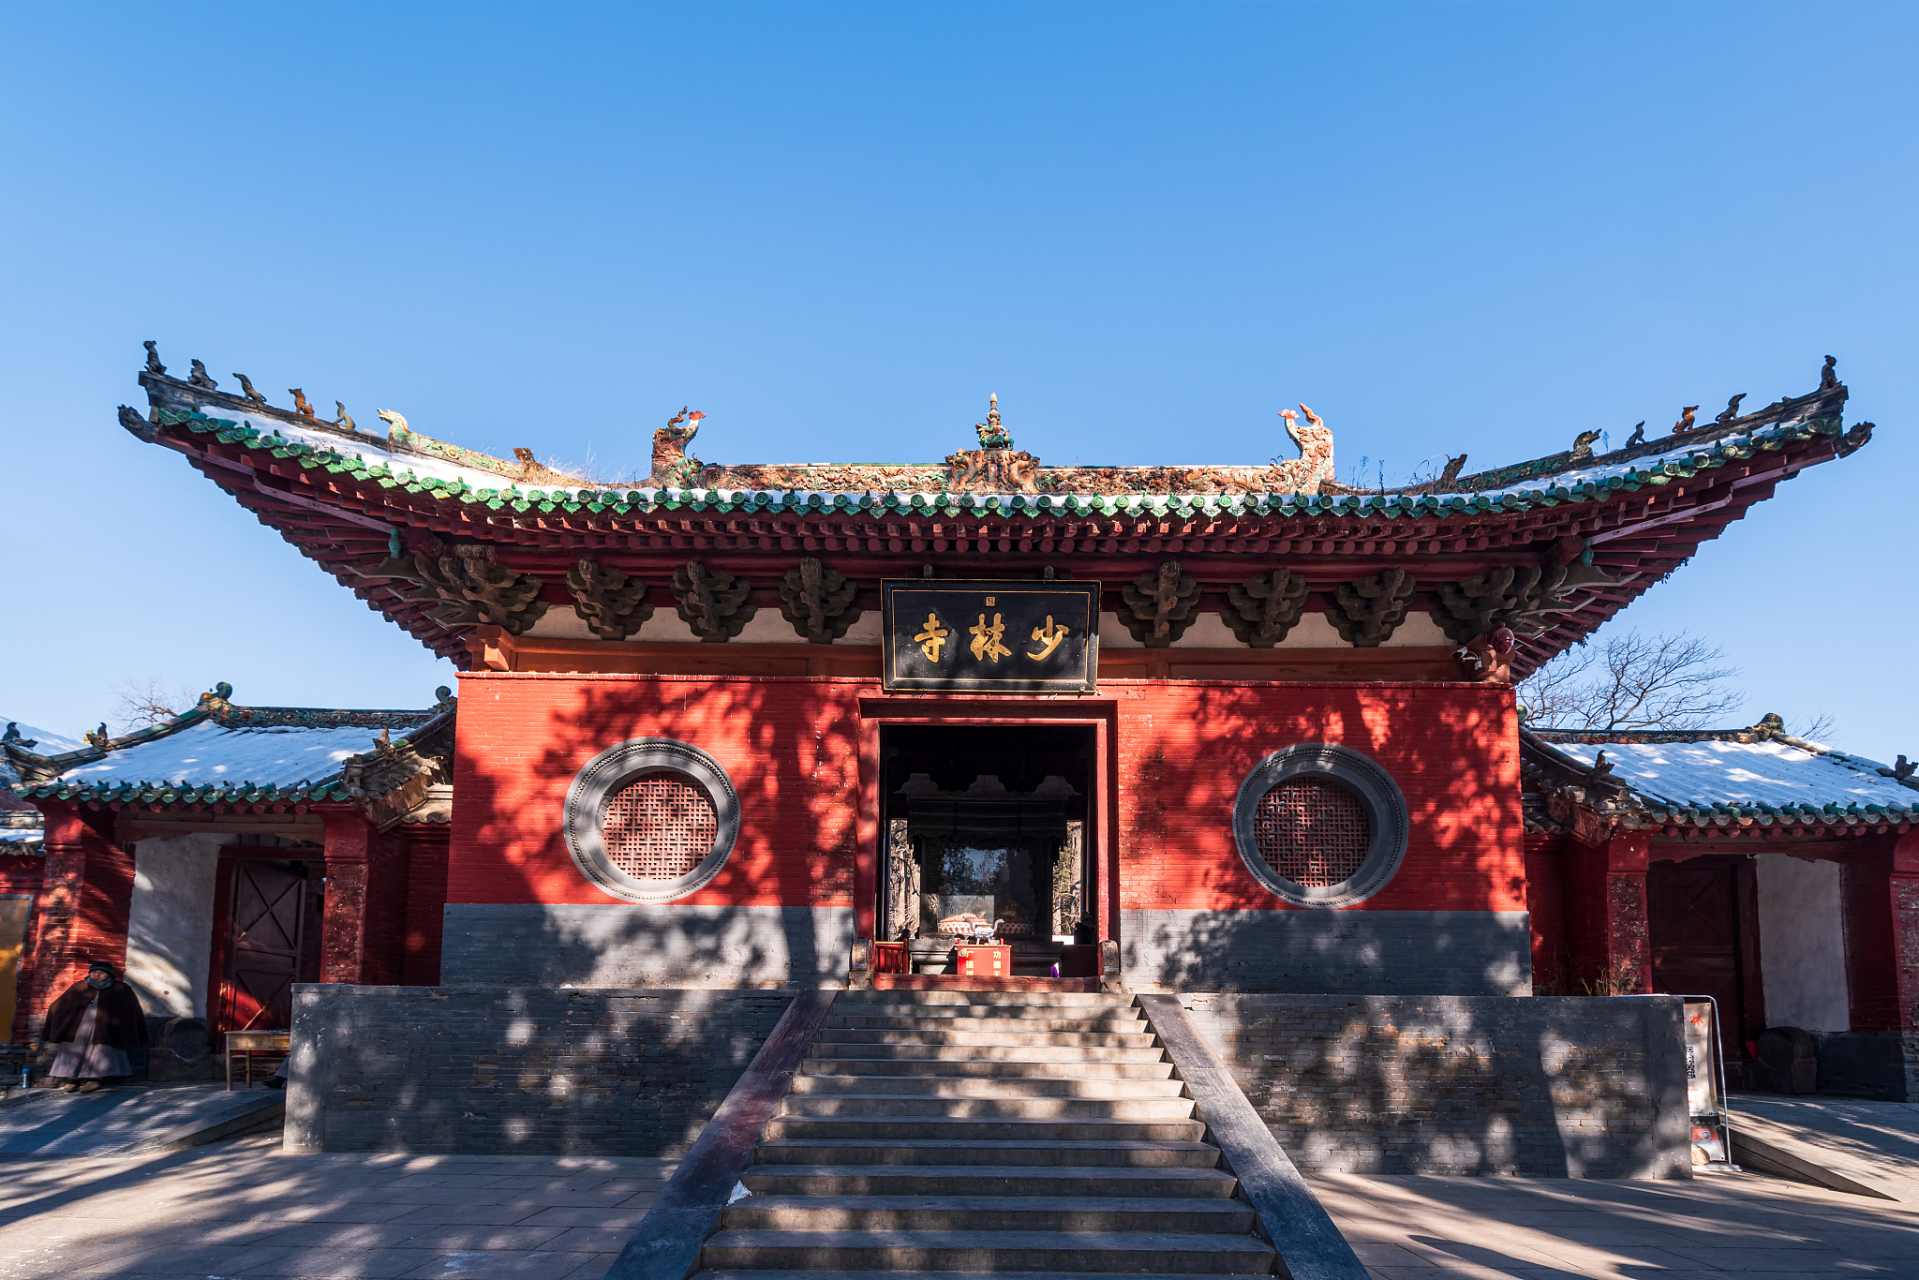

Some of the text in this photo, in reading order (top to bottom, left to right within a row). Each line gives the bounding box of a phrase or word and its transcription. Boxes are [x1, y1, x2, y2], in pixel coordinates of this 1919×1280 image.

[914, 612, 1070, 663] 少林寺
[1684, 1013, 1704, 1026] 林
